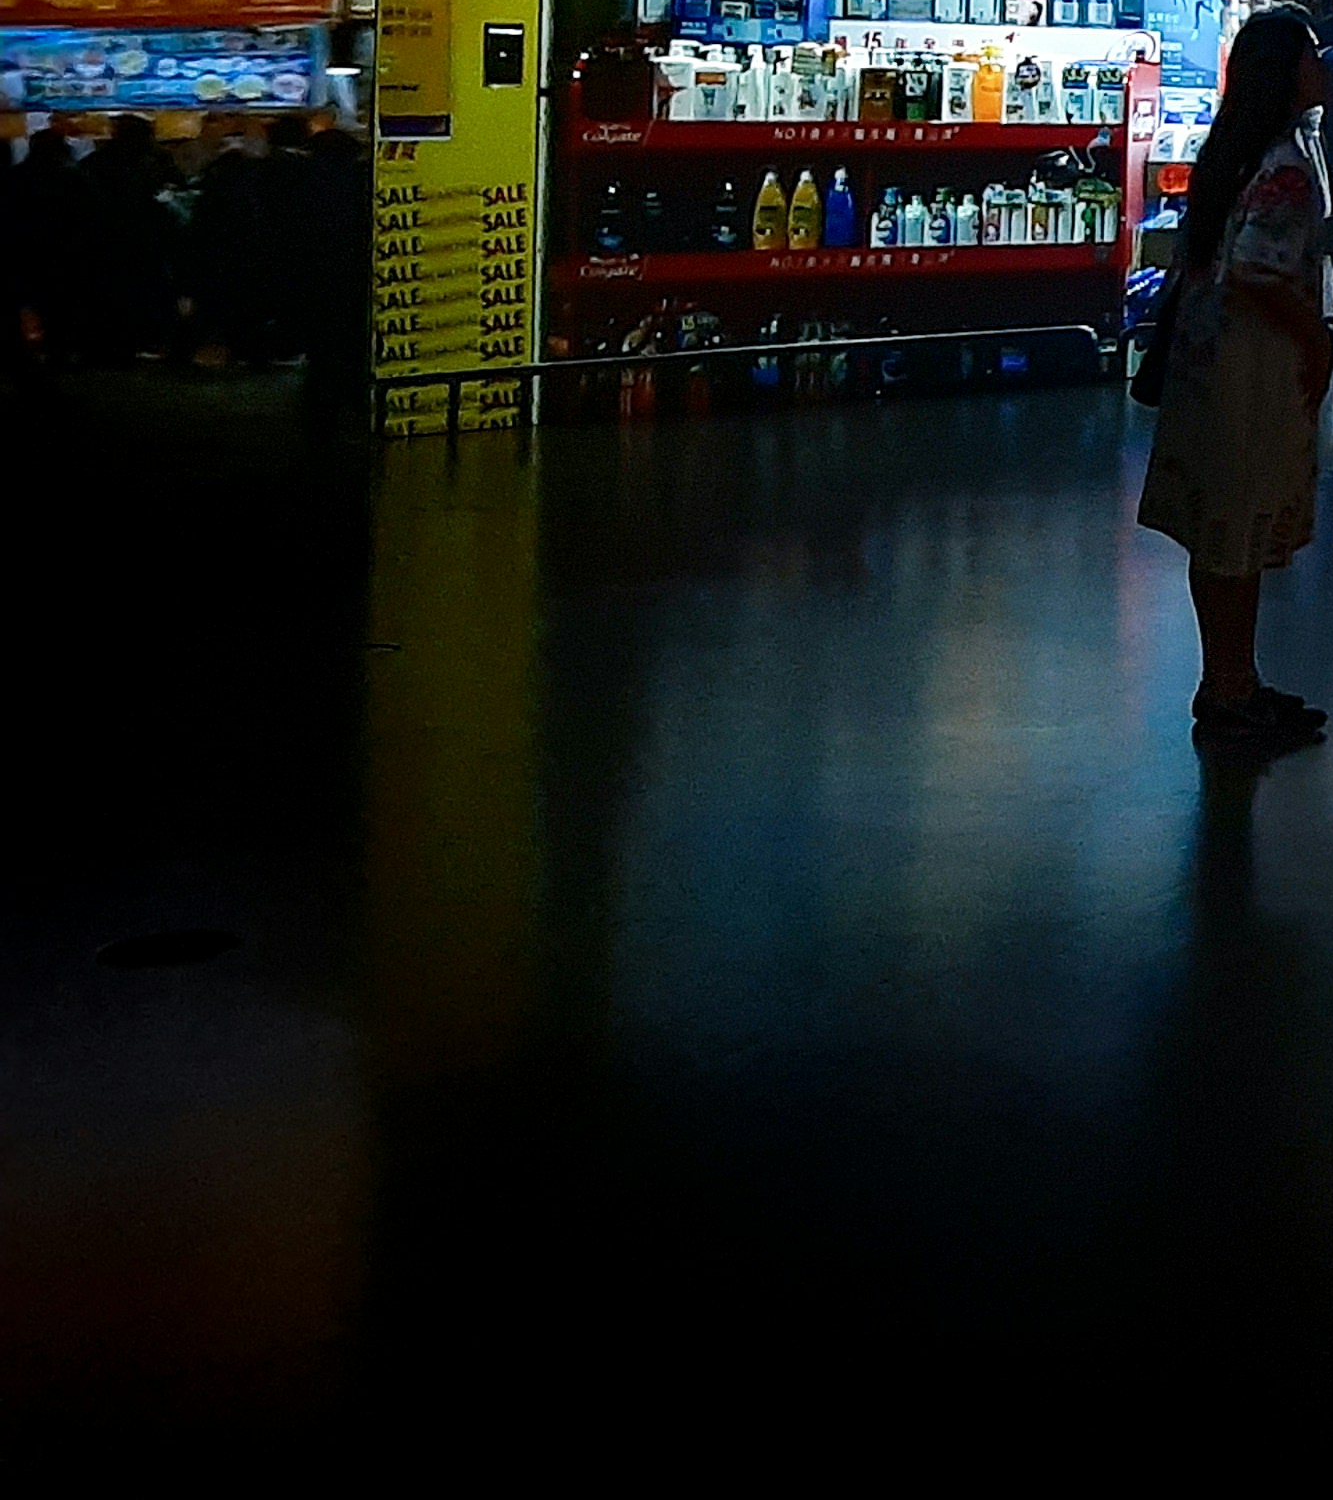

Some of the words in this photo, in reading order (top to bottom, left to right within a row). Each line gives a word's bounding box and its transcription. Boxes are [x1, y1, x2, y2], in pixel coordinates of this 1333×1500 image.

[376, 186, 424, 208] SALE
[480, 183, 527, 206] SALE
[480, 208, 527, 232] SALE
[480, 234, 526, 258] SALE
[480, 259, 526, 284] SALE
[479, 284, 525, 309] SALE
[386, 313, 422, 336] ALE
[479, 309, 525, 335] SALE
[385, 341, 421, 362] ALE
[479, 336, 525, 362] SALE
